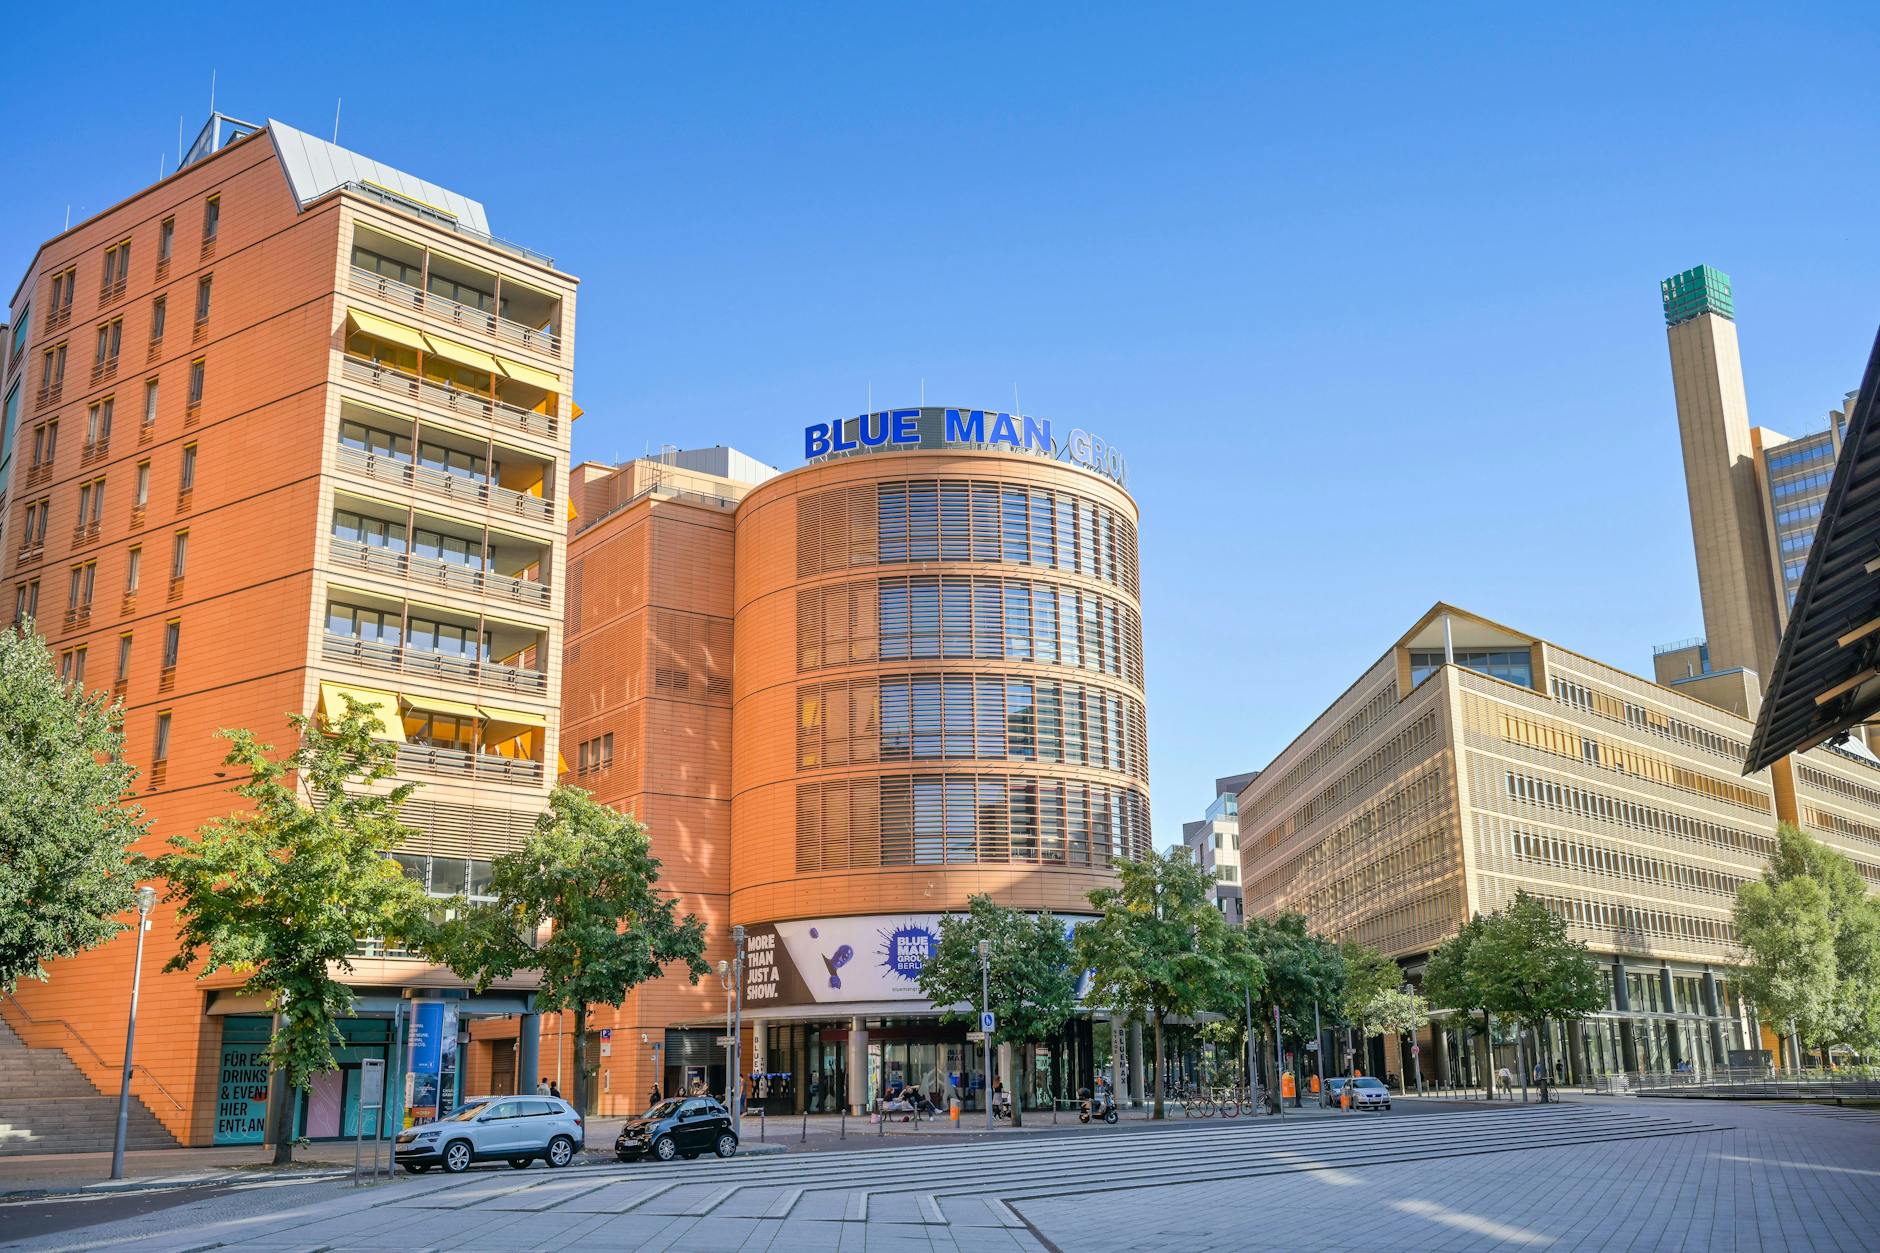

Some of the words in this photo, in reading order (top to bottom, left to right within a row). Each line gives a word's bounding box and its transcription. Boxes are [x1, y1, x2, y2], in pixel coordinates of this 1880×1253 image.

[805, 409, 921, 459] BLUE
[944, 409, 1052, 452] MAN
[748, 934, 775, 952] MORE
[897, 936, 928, 946] BLUE
[897, 945, 928, 956] MAN
[748, 951, 773, 967] THAN
[747, 968, 769, 984] JUST
[770, 967, 779, 981] A
[746, 983, 778, 1000] SHOW.
[223, 1051, 247, 1067] FÜR
[222, 1069, 268, 1083] DRINKS
[221, 1086, 230, 1100] &
[220, 1102, 248, 1117] HIER
